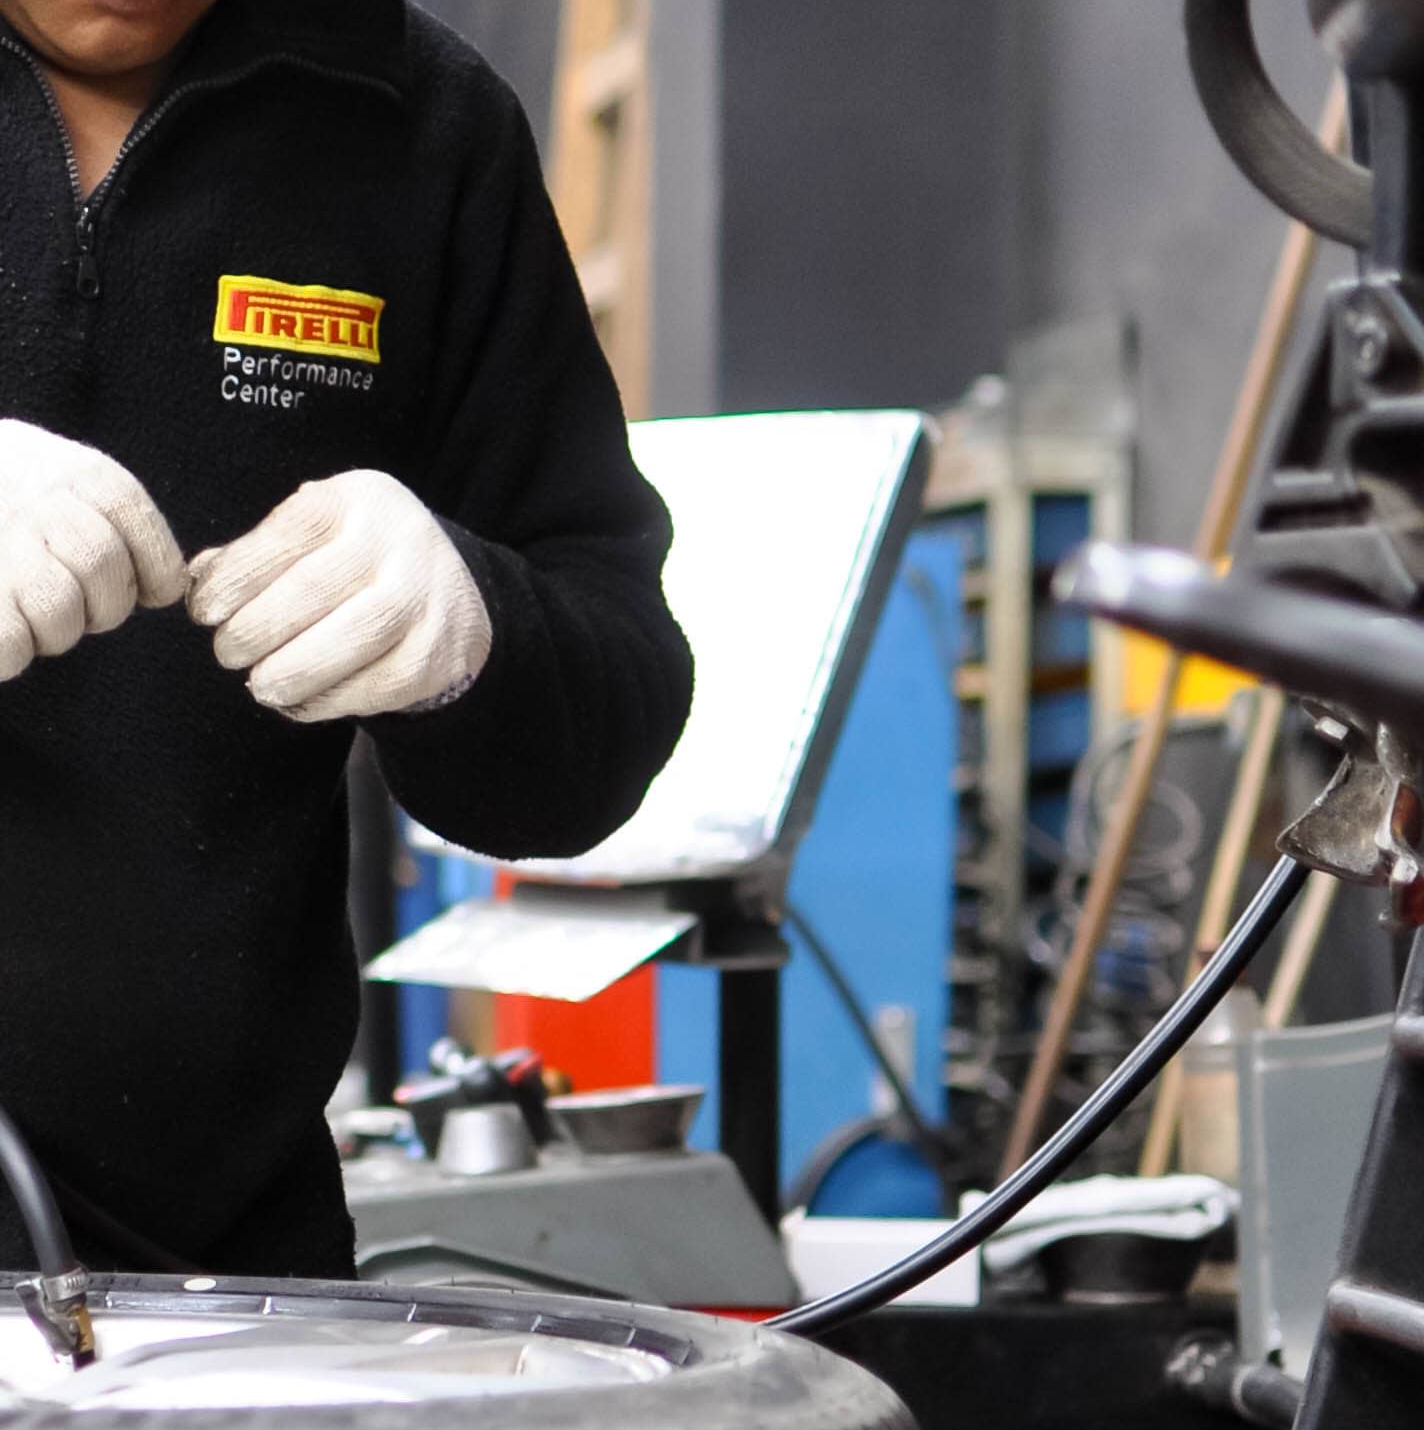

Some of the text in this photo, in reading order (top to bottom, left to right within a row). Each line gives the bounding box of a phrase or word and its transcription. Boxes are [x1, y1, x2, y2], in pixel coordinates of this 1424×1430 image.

[229, 290, 376, 349] PIRELLI
[224, 346, 374, 390] Performance
[221, 374, 305, 408] Center
